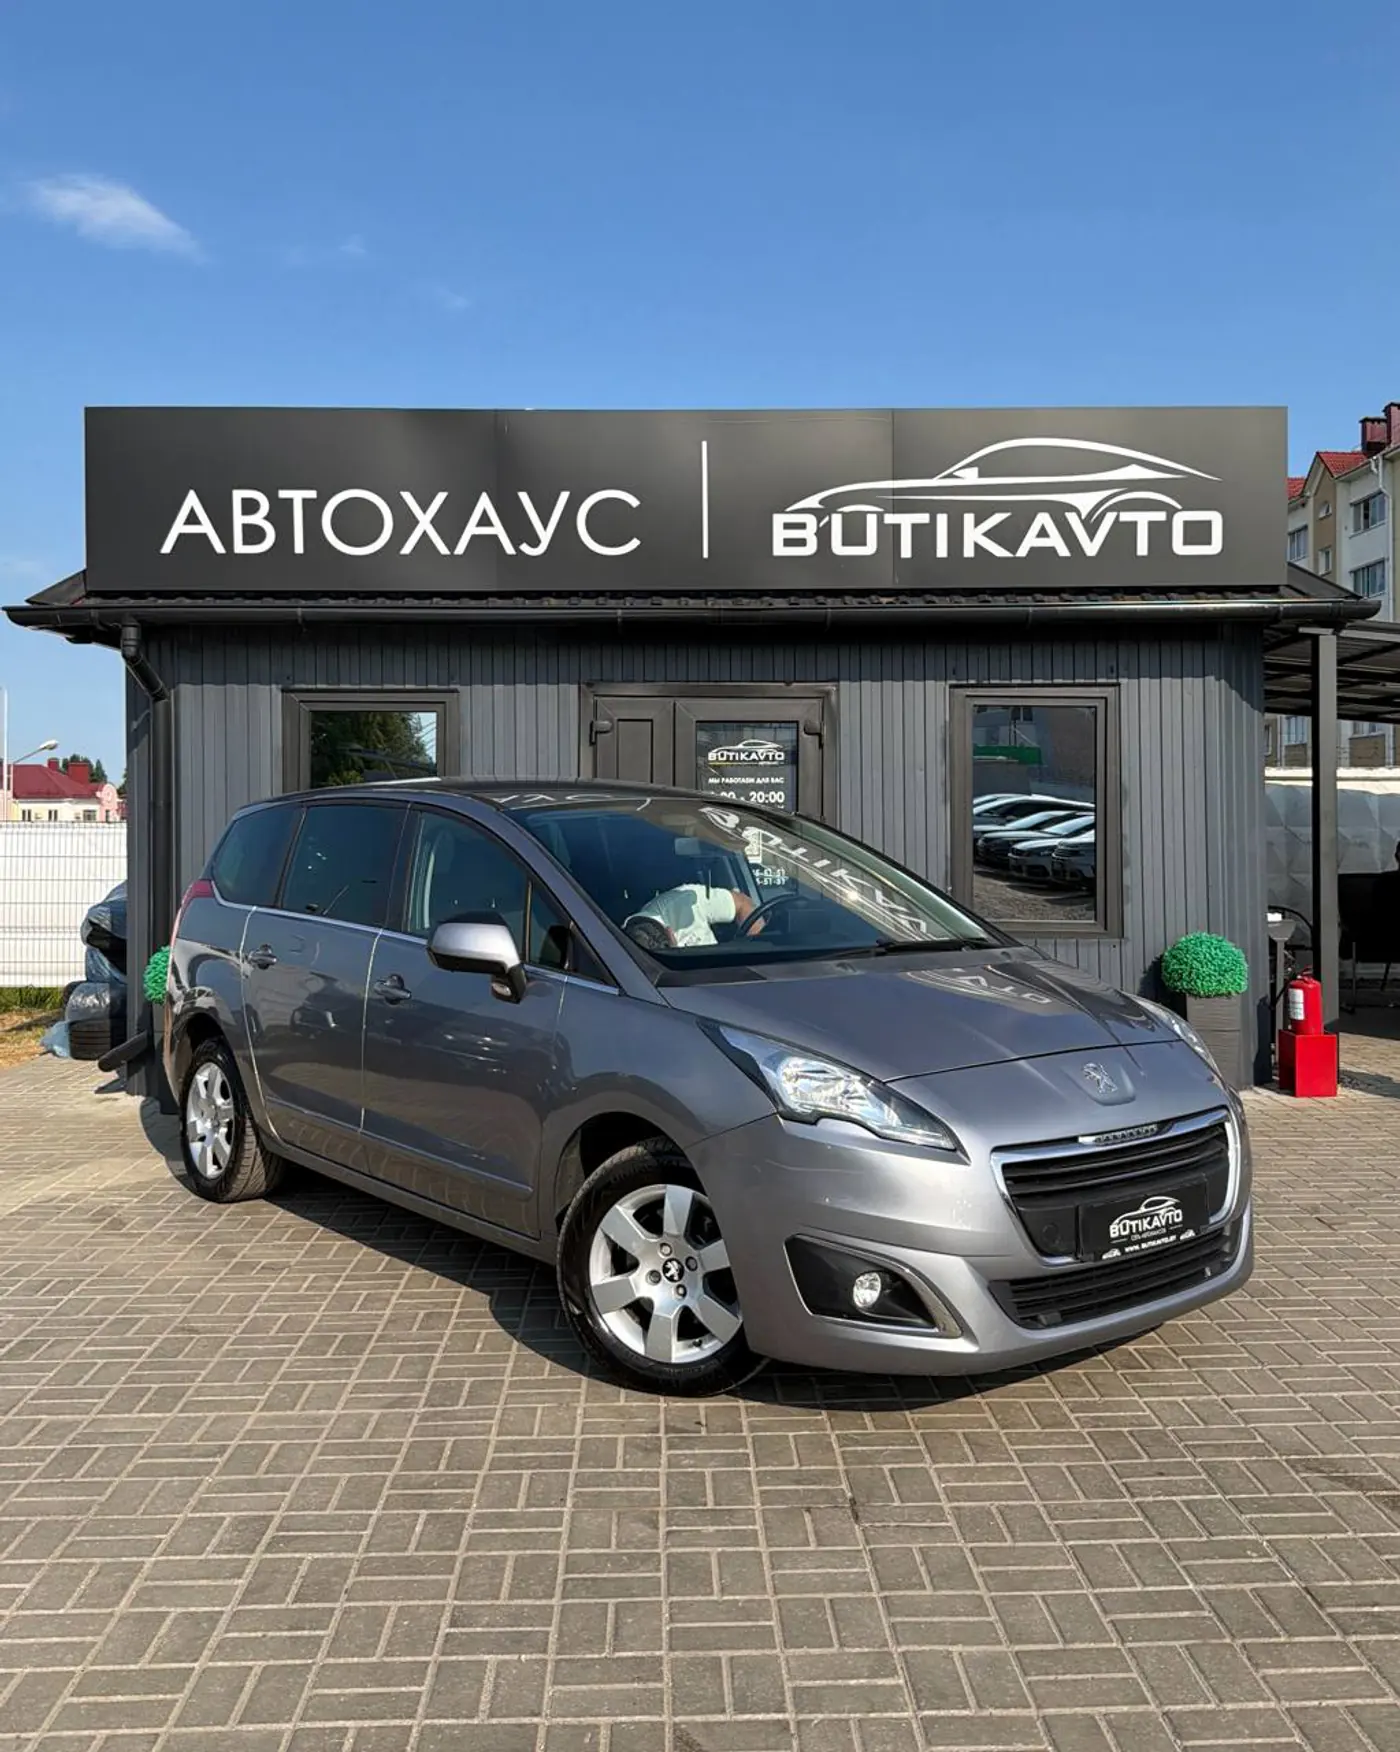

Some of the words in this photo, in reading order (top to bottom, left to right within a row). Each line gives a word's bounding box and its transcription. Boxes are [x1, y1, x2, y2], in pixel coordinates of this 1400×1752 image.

[159, 488, 642, 557] АВТОХАУС
[771, 509, 1225, 559] BUTIKAVTO
[708, 752, 785, 761] BUTIKAVTO
[1109, 1209, 1183, 1238] BUTIKAVTO
